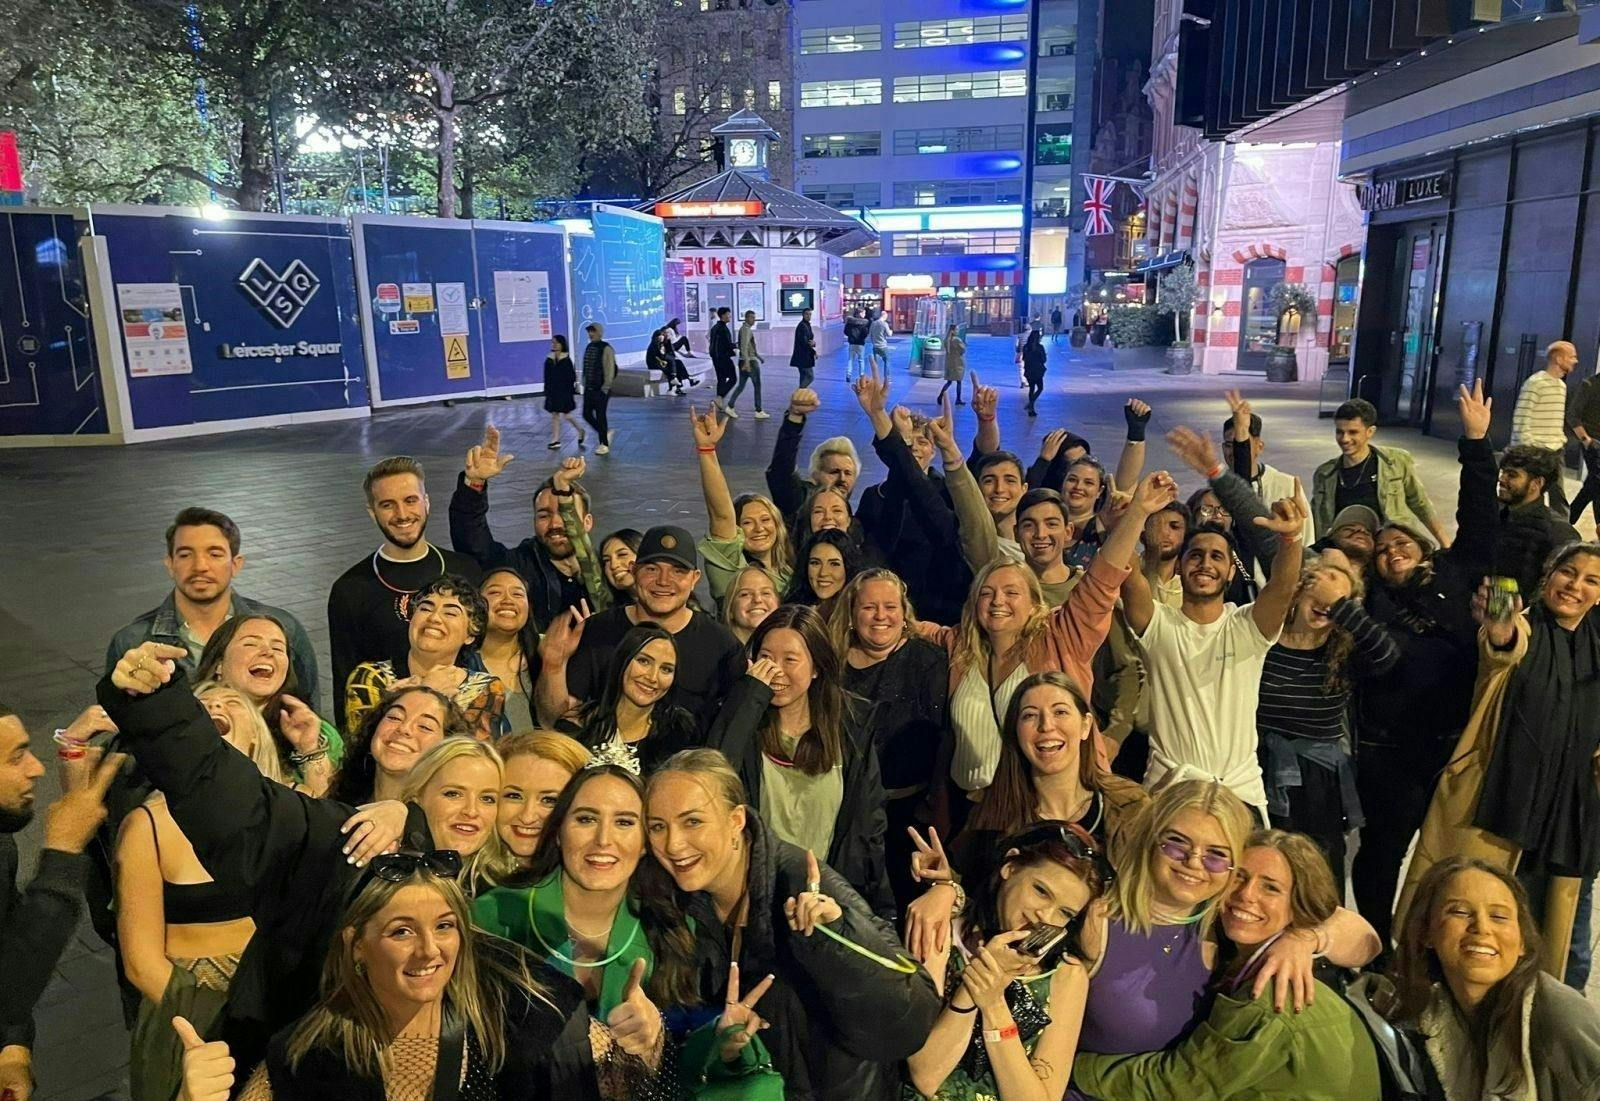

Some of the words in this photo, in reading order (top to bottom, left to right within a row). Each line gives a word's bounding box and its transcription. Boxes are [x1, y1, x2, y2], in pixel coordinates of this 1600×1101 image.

[1361, 180, 1398, 211] ODEON
[1409, 177, 1441, 198] LUXE
[696, 256, 755, 276] tkts
[223, 342, 296, 358] Leicester
